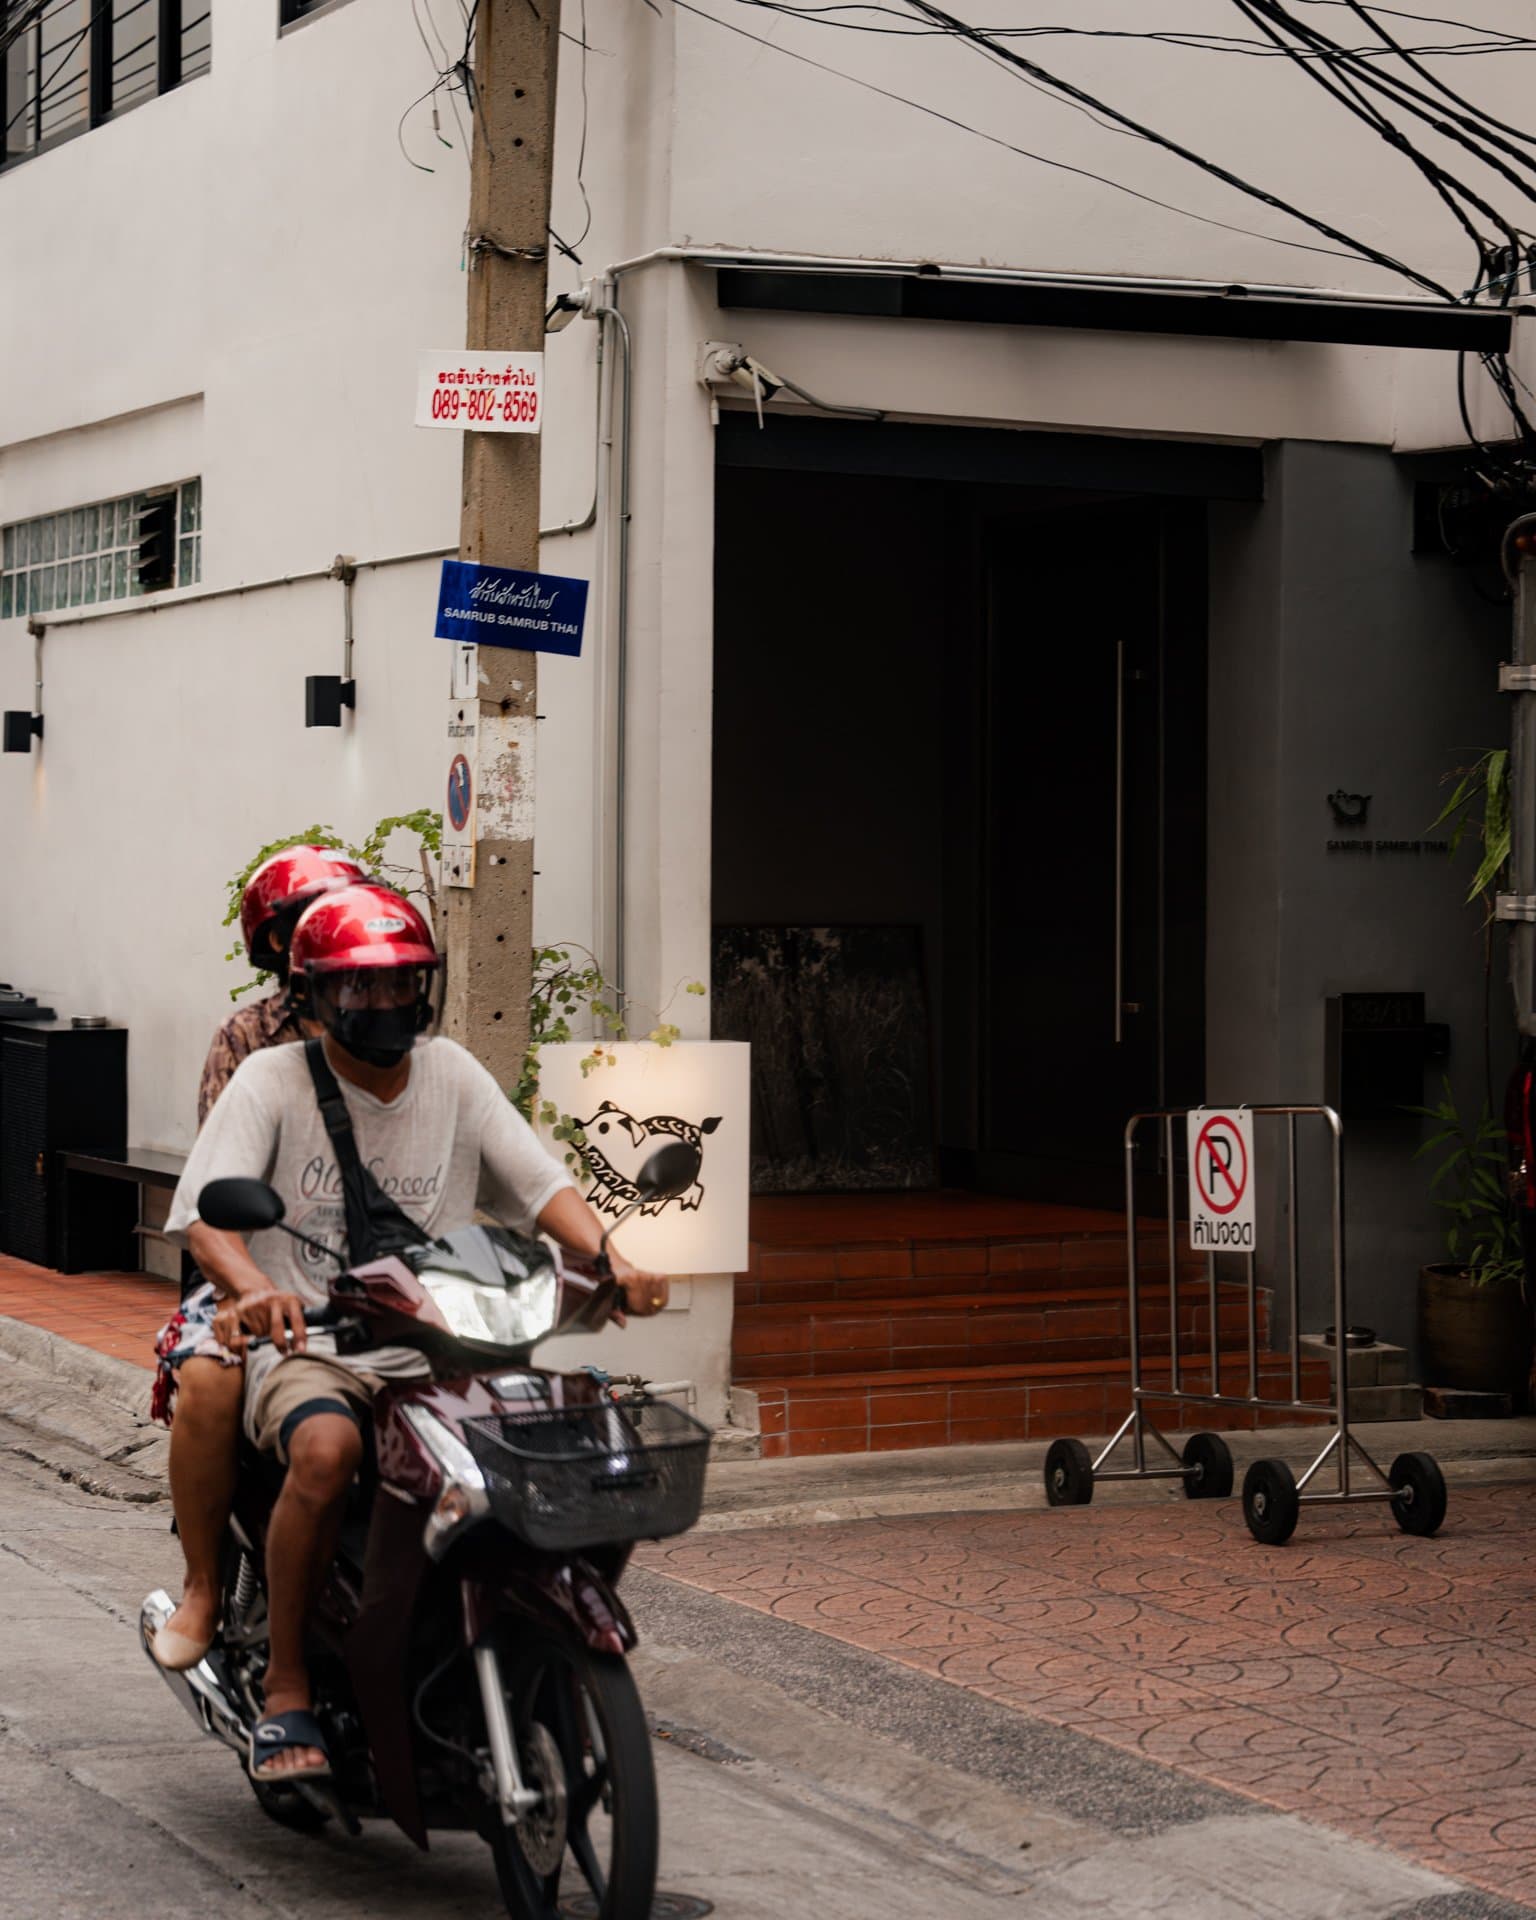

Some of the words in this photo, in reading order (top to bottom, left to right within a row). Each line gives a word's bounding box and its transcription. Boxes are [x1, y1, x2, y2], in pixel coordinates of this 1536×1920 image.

[432, 388, 537, 422] 089-802-8569
[443, 607, 496, 624] SAMRUB
[497, 614, 549, 631] SAMRUB
[550, 622, 579, 635] THAI
[1193, 1214, 1252, 1245] ห้ามจอด
